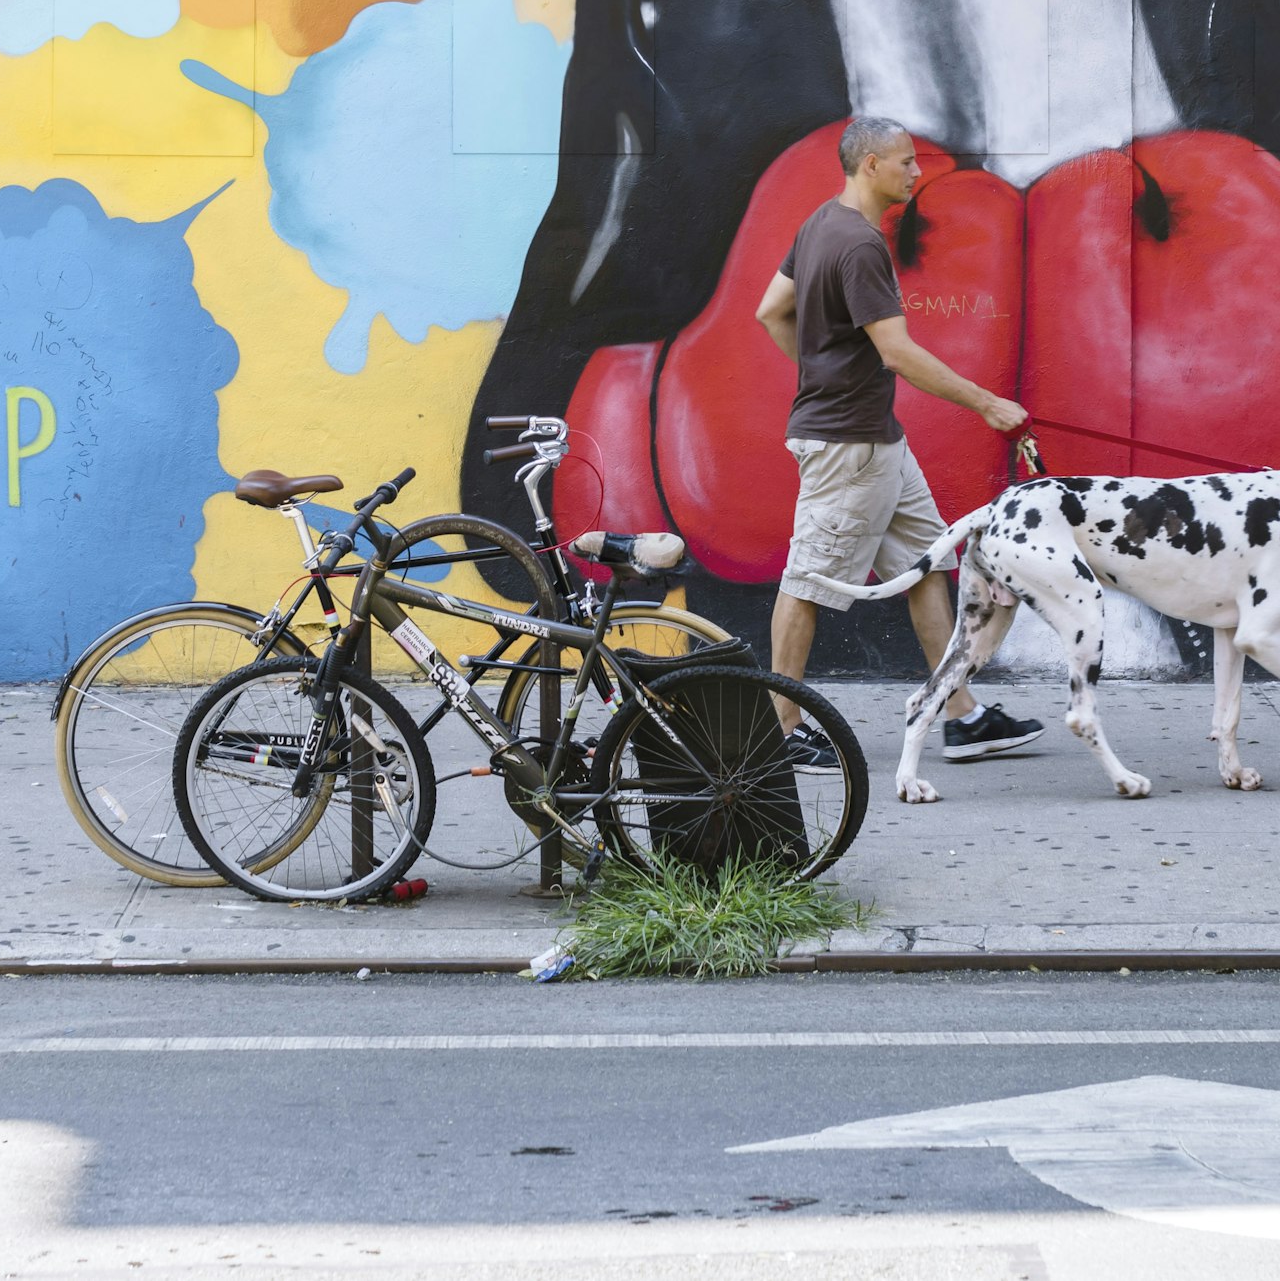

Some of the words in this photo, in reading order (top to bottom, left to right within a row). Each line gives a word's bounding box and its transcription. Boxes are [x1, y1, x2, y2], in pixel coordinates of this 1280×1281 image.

[402, 622, 432, 655] HAMTRAMCK
[492, 613, 551, 639] TUNDRA
[400, 631, 424, 656] CERAMCK
[269, 735, 305, 746] PUBLI
